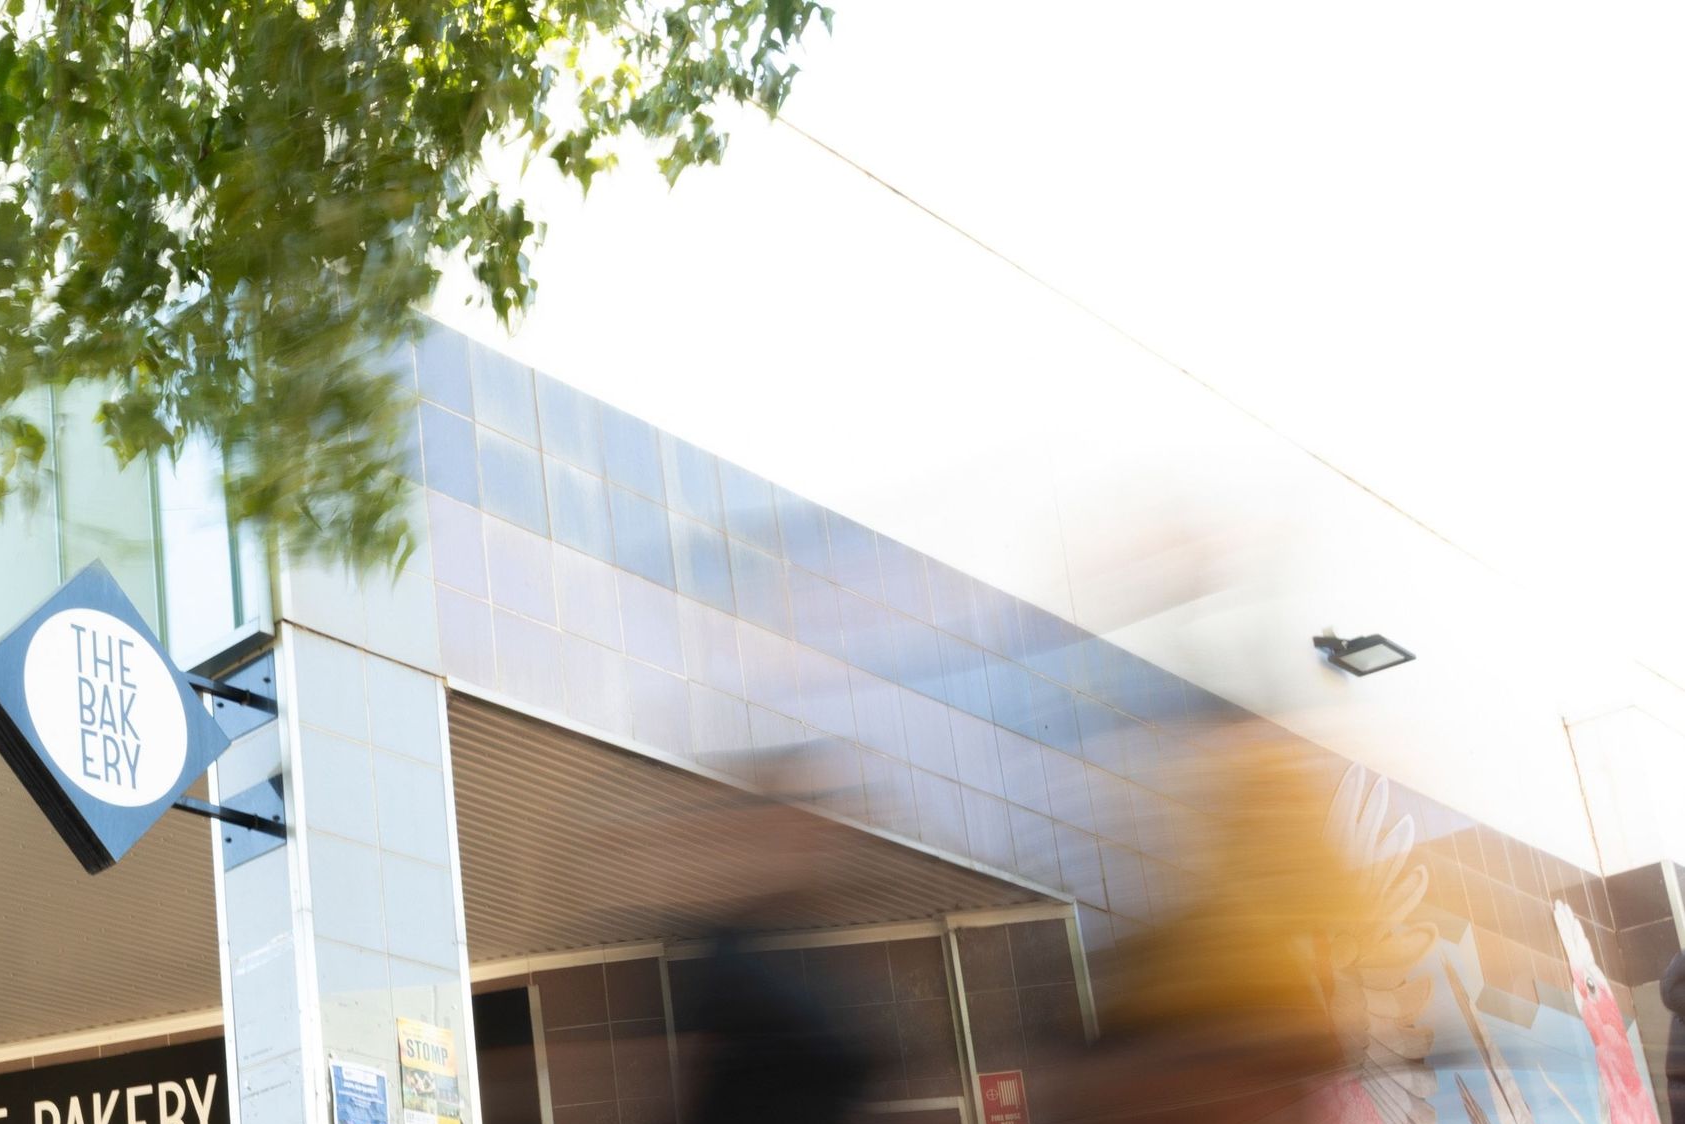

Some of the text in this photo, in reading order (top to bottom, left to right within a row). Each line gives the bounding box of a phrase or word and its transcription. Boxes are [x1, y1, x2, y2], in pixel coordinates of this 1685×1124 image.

[70, 622, 137, 689] THE
[78, 676, 140, 741] BAK
[80, 727, 141, 790] ERY
[406, 1038, 448, 1065] STOMP
